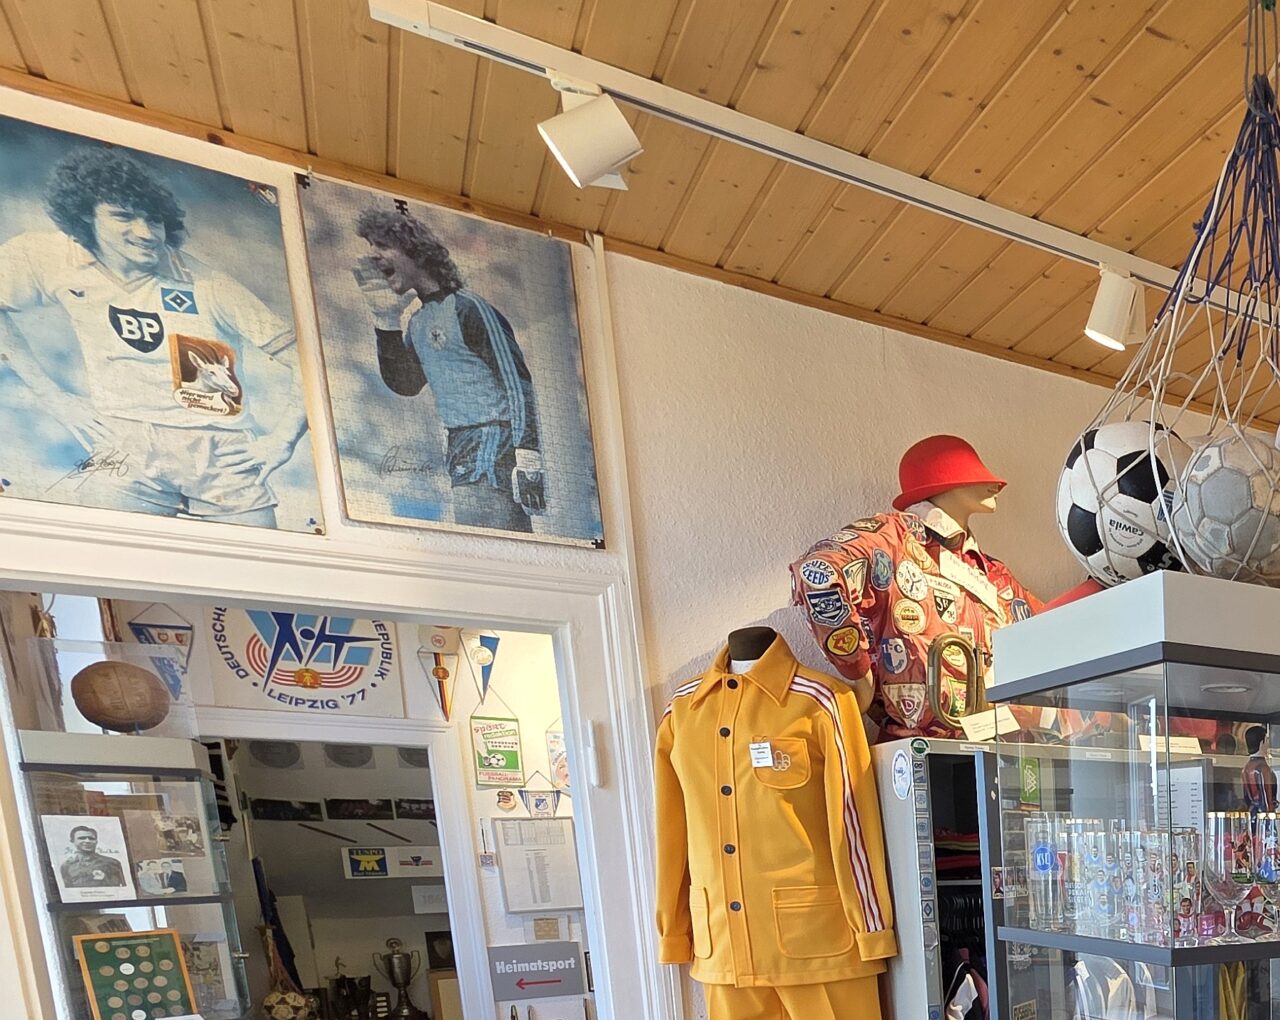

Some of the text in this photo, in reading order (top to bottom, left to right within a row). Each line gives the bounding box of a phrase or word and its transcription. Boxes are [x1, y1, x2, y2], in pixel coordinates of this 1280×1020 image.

[117, 314, 160, 343] BP
[1109, 519, 1144, 537] cawila
[802, 560, 835, 577] SUPER
[802, 568, 831, 585] LEEDS
[267, 688, 339, 710] LEIPZIG
[495, 957, 576, 974] Heimatsport
